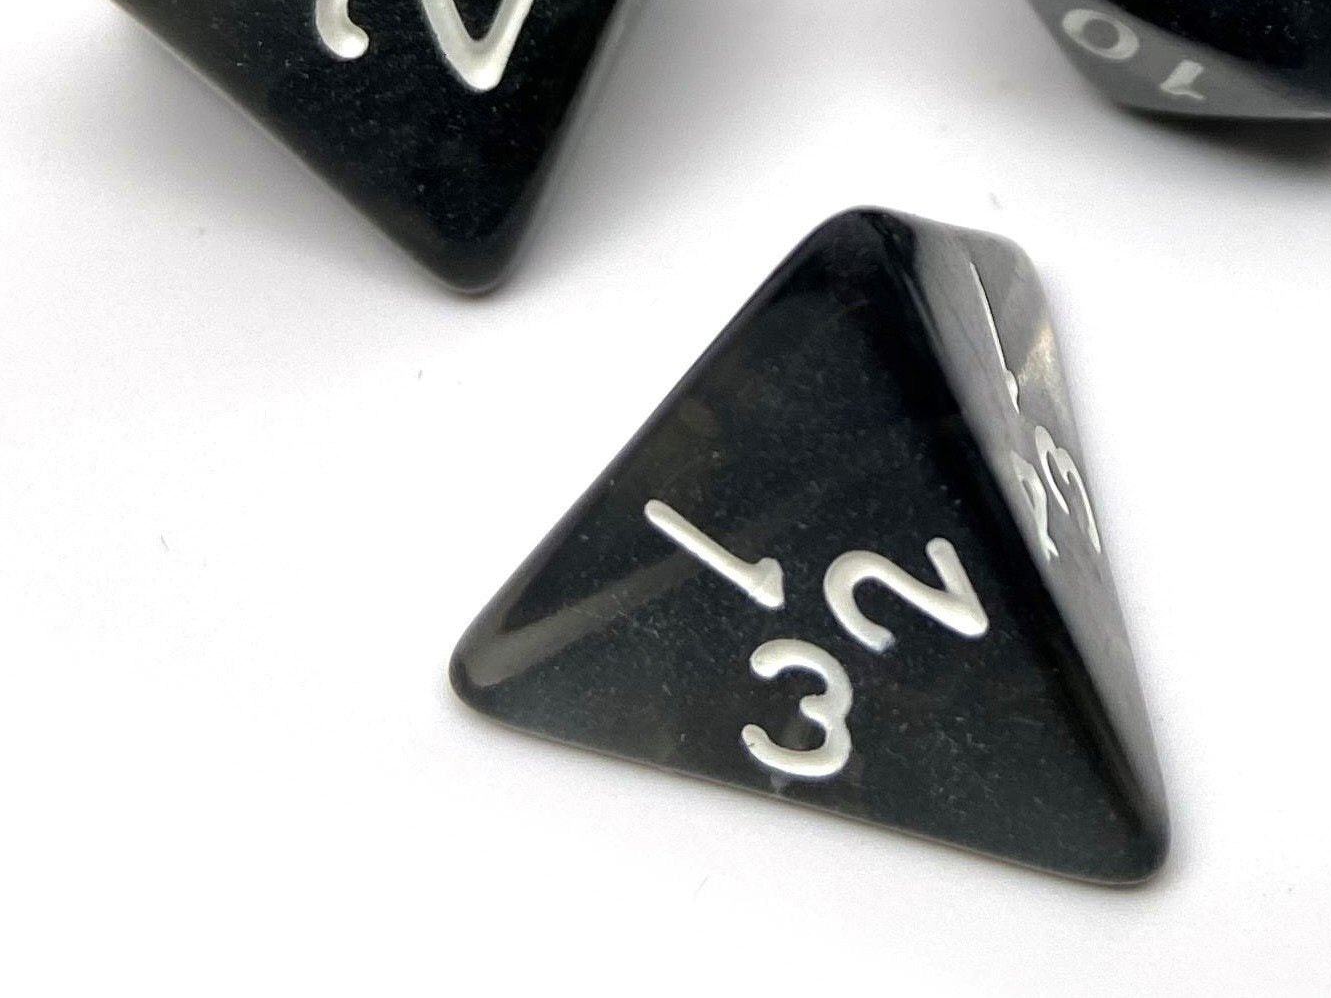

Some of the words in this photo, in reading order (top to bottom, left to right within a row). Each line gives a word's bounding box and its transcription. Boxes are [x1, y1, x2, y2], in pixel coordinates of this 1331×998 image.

[645, 500, 784, 608] 1
[824, 539, 987, 651] 2
[742, 640, 852, 777] 3
